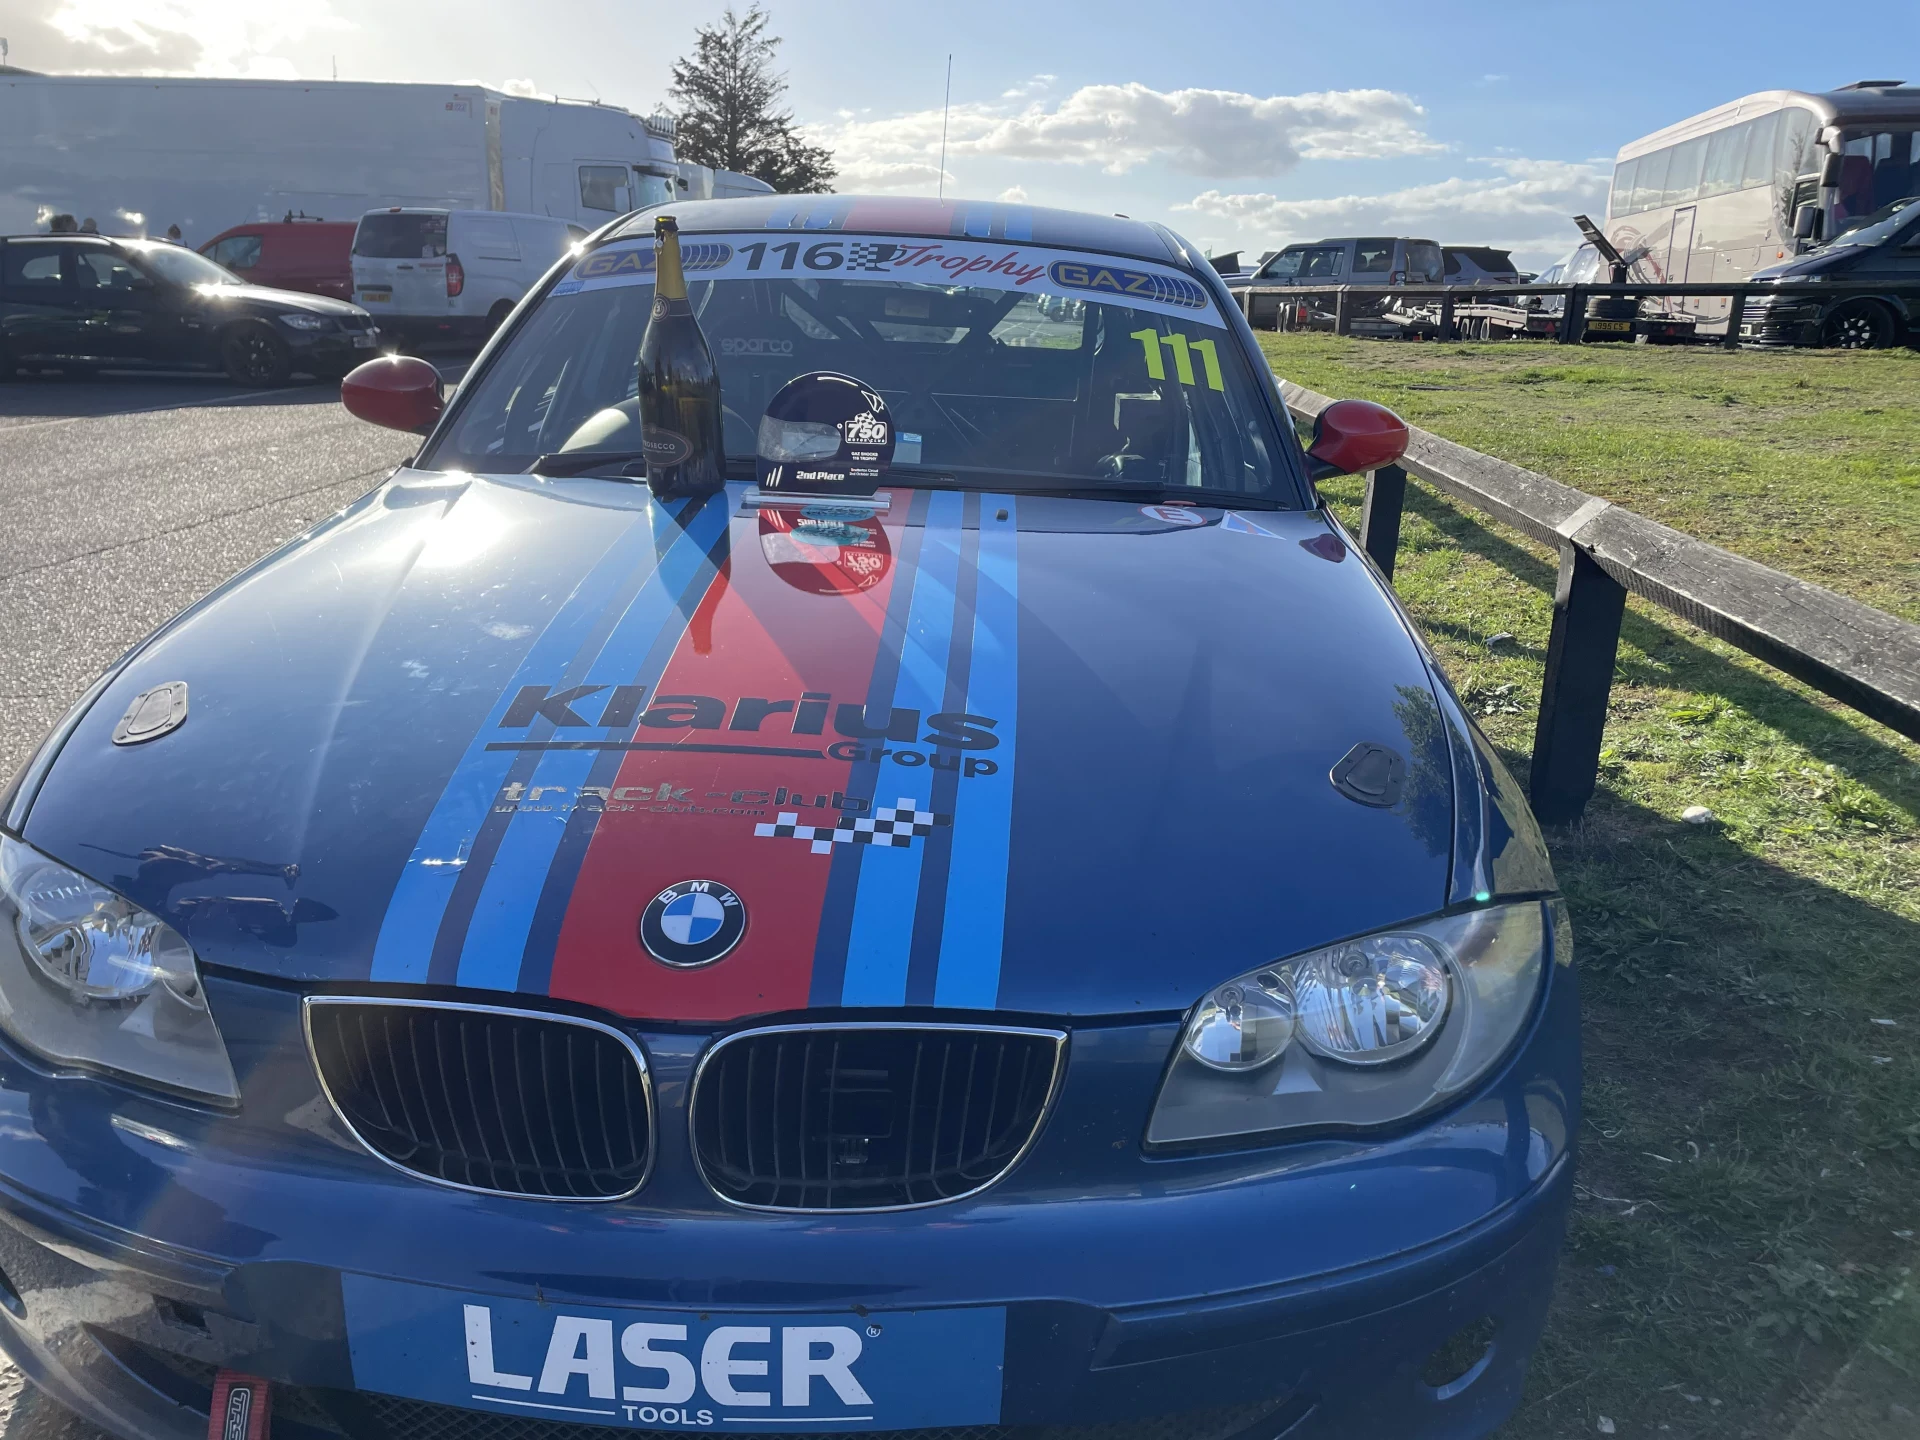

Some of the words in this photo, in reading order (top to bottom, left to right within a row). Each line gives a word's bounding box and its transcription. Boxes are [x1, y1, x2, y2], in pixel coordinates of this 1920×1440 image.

[738, 241, 845, 271] 116
[893, 244, 1046, 286] Trophy
[1058, 264, 1150, 296] GAZ
[1130, 328, 1225, 392] 111
[848, 423, 885, 439] 750
[796, 470, 817, 480] 2nd
[817, 471, 845, 481] Place
[497, 685, 1000, 751] Klarius
[827, 741, 999, 778] Group
[658, 882, 739, 907] BMW
[621, 1405, 714, 1425] TOOLS
